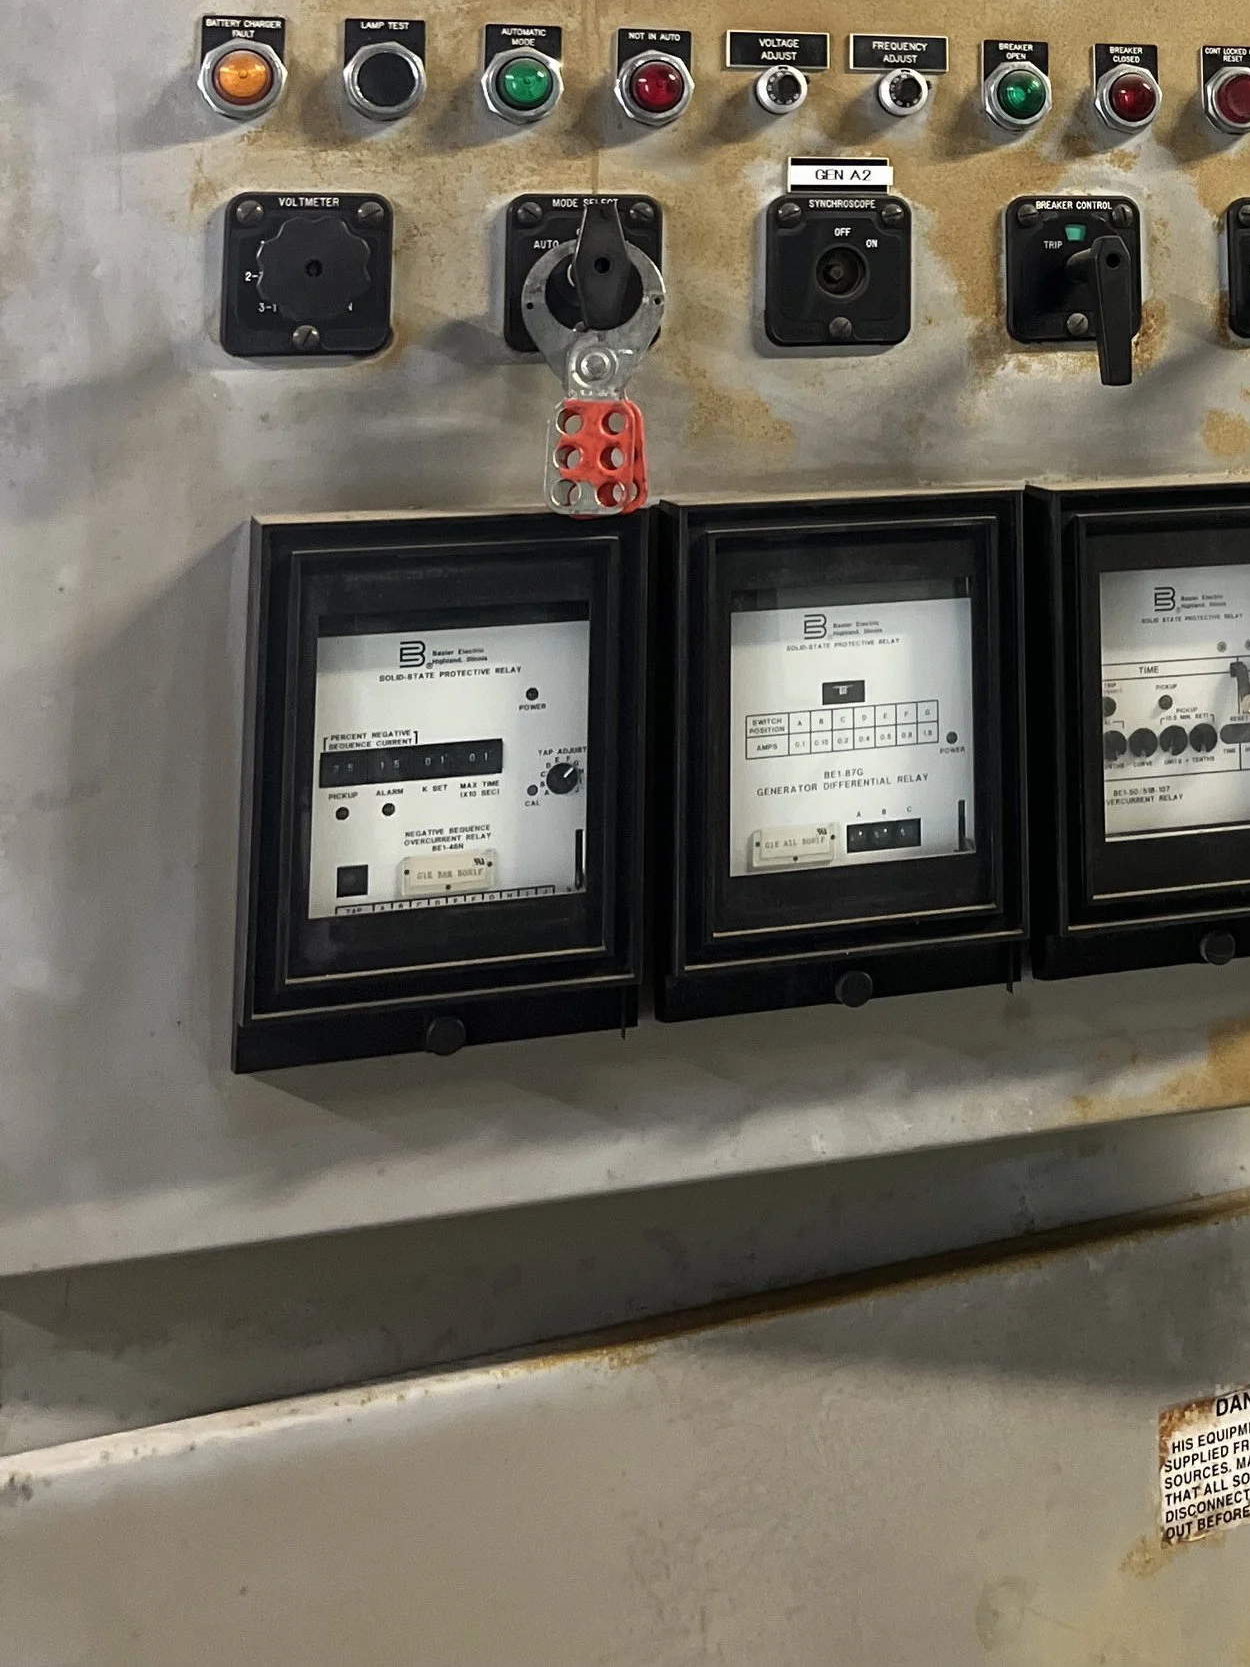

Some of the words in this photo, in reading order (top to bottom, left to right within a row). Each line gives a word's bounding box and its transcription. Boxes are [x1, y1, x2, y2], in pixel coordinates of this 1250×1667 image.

[206, 19, 241, 28] BATTERY
[244, 19, 282, 29] CHARGER
[361, 22, 384, 30] LAMP
[388, 22, 410, 31] TEST
[501, 28, 546, 37] AUTOMATIC
[759, 38, 799, 48] VOLTAGE
[872, 42, 928, 53] FREQUENCY
[999, 43, 1034, 51] BREAKER
[761, 50, 797, 61] ADJUST
[1110, 46, 1143, 55] BREAKER
[883, 54, 918, 64] ADJUST
[1113, 55, 1140, 63] CLOSED
[815, 169, 844, 181] GEN
[850, 170, 871, 182] A2
[279, 197, 340, 208] VOLTMETER
[809, 199, 876, 210] SYNCHROSCOPE
[1036, 200, 1072, 210] BREAKER
[1075, 201, 1112, 211] CONTROL
[834, 227, 851, 237] OFF
[534, 240, 559, 249] AUTO
[379, 672, 434, 682] SOLID-STATE
[440, 668, 490, 678] PROTECTIVE
[495, 666, 521, 674] RELAY
[1138, 666, 1160, 674] TIME
[752, 718, 782, 726] SWITCH
[749, 725, 785, 734] POSITION
[331, 732, 367, 741] PERCENT
[371, 730, 411, 738] NEGATIVE
[329, 741, 371, 750] SEQUENCE
[376, 738, 412, 746] CURRENT
[757, 782, 818, 797] GENERATOR
[823, 776, 891, 791] DIFFERENTIAL
[897, 773, 929, 784] RELAY
[405, 828, 444, 838] NEGATIVE
[449, 825, 491, 833] SEQUENCE
[404, 836, 461, 846] OVERCURRENT
[466, 833, 491, 841] RELAY
[1164, 1446, 1229, 1473] SUPPLIED
[1165, 1485, 1200, 1506] THAT
[1204, 1478, 1228, 1496] ALL
